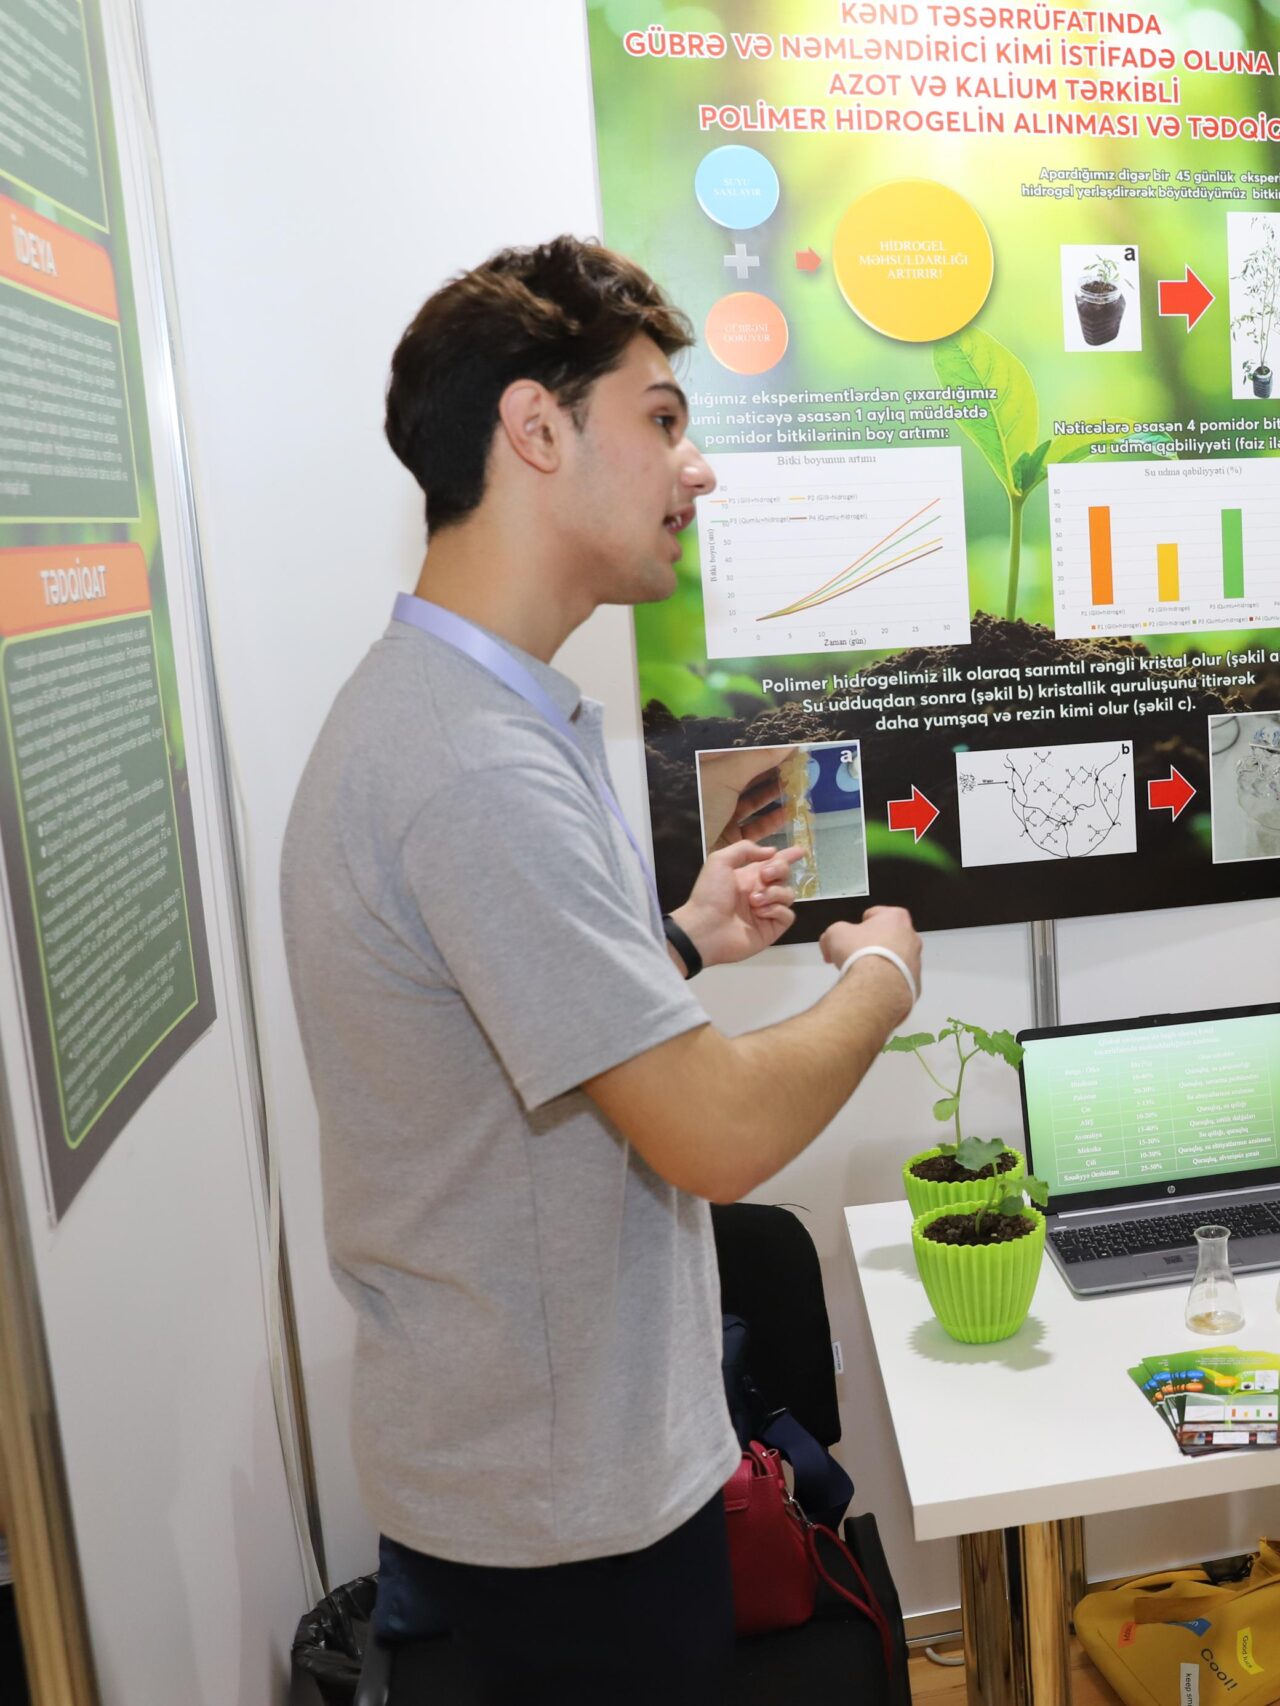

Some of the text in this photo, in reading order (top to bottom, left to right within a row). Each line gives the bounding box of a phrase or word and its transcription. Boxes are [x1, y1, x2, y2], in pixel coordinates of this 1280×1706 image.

[842, 2, 1162, 35] KƏND TƏSƏRRÜFATINDA
[624, 27, 725, 57] GÜBRƏ
[734, 34, 773, 57] VƏ
[781, 35, 986, 63] NƏMLƏNDİRİCİ
[996, 37, 1051, 65] KİMİ
[1060, 39, 1175, 69] İSTİFADƏ
[1183, 50, 1272, 74] OLUNA
[829, 72, 1180, 103] AZOT VƏ KALİUM TƏRKİBLİ
[700, 101, 827, 129] POLİMER
[836, 103, 1004, 133] HİDROGELİN
[1013, 113, 1138, 136] ALINMASI
[1146, 116, 1180, 137] VƏ
[1039, 167, 1115, 182] Apardığımız
[1118, 169, 1150, 184] digər
[1153, 169, 1170, 181] bir
[1176, 171, 1191, 182] 45
[1194, 171, 1234, 185] günlük
[1021, 184, 1074, 199] hidrogel
[1077, 185, 1155, 201] yerləşdirərək
[1158, 186, 1246, 201] böyütdüyümüz
[1124, 248, 1136, 262] a
[752, 387, 900, 407] eksperimentlərdən
[903, 386, 998, 404] çıxardığımız
[726, 411, 793, 427] nəticəyə
[797, 411, 850, 424] əsasən
[856, 408, 863, 422] 1
[867, 407, 905, 424] aylıq
[910, 406, 988, 420] müddətdə
[1054, 420, 1130, 435] Nəticələrə
[1133, 422, 1183, 434] əsasən
[1187, 419, 1196, 432] 4
[1200, 419, 1260, 435] pomidor
[705, 425, 949, 448] pomidor bitkilərinin boy artımı:
[1090, 443, 1107, 454] su
[1110, 440, 1152, 454] udma
[1156, 437, 1231, 455] qabiliyyəti
[1235, 436, 1265, 452] (faiz
[777, 455, 801, 466] Bitki
[803, 456, 846, 468] boyunun
[1144, 468, 1156, 477] Su
[1158, 467, 1180, 477] udma
[1182, 466, 1225, 478] qabiliyyəti
[40, 557, 106, 605] TƏDQİQAT
[824, 638, 846, 646] Zaman
[762, 675, 828, 694] Polimer
[833, 672, 938, 691] hidrogelimiz
[942, 668, 962, 683] ilk
[966, 666, 1021, 683] olaraq
[1025, 660, 1085, 677] sarımtıl
[1090, 658, 1134, 677] rəngli
[1139, 655, 1187, 670] kristal
[1192, 652, 1222, 668] olur
[1226, 649, 1265, 668] (şəkil
[802, 671, 1256, 713] Su udduqdan sonra (şəkil b) kristallik quruluşunu itirərək
[875, 696, 1197, 731] daha yumşaq və rezin kimi olur (şəkil c).
[839, 748, 853, 762] a
[1120, 743, 1130, 756] b
[1201, 1648, 1238, 1691] Cool!
